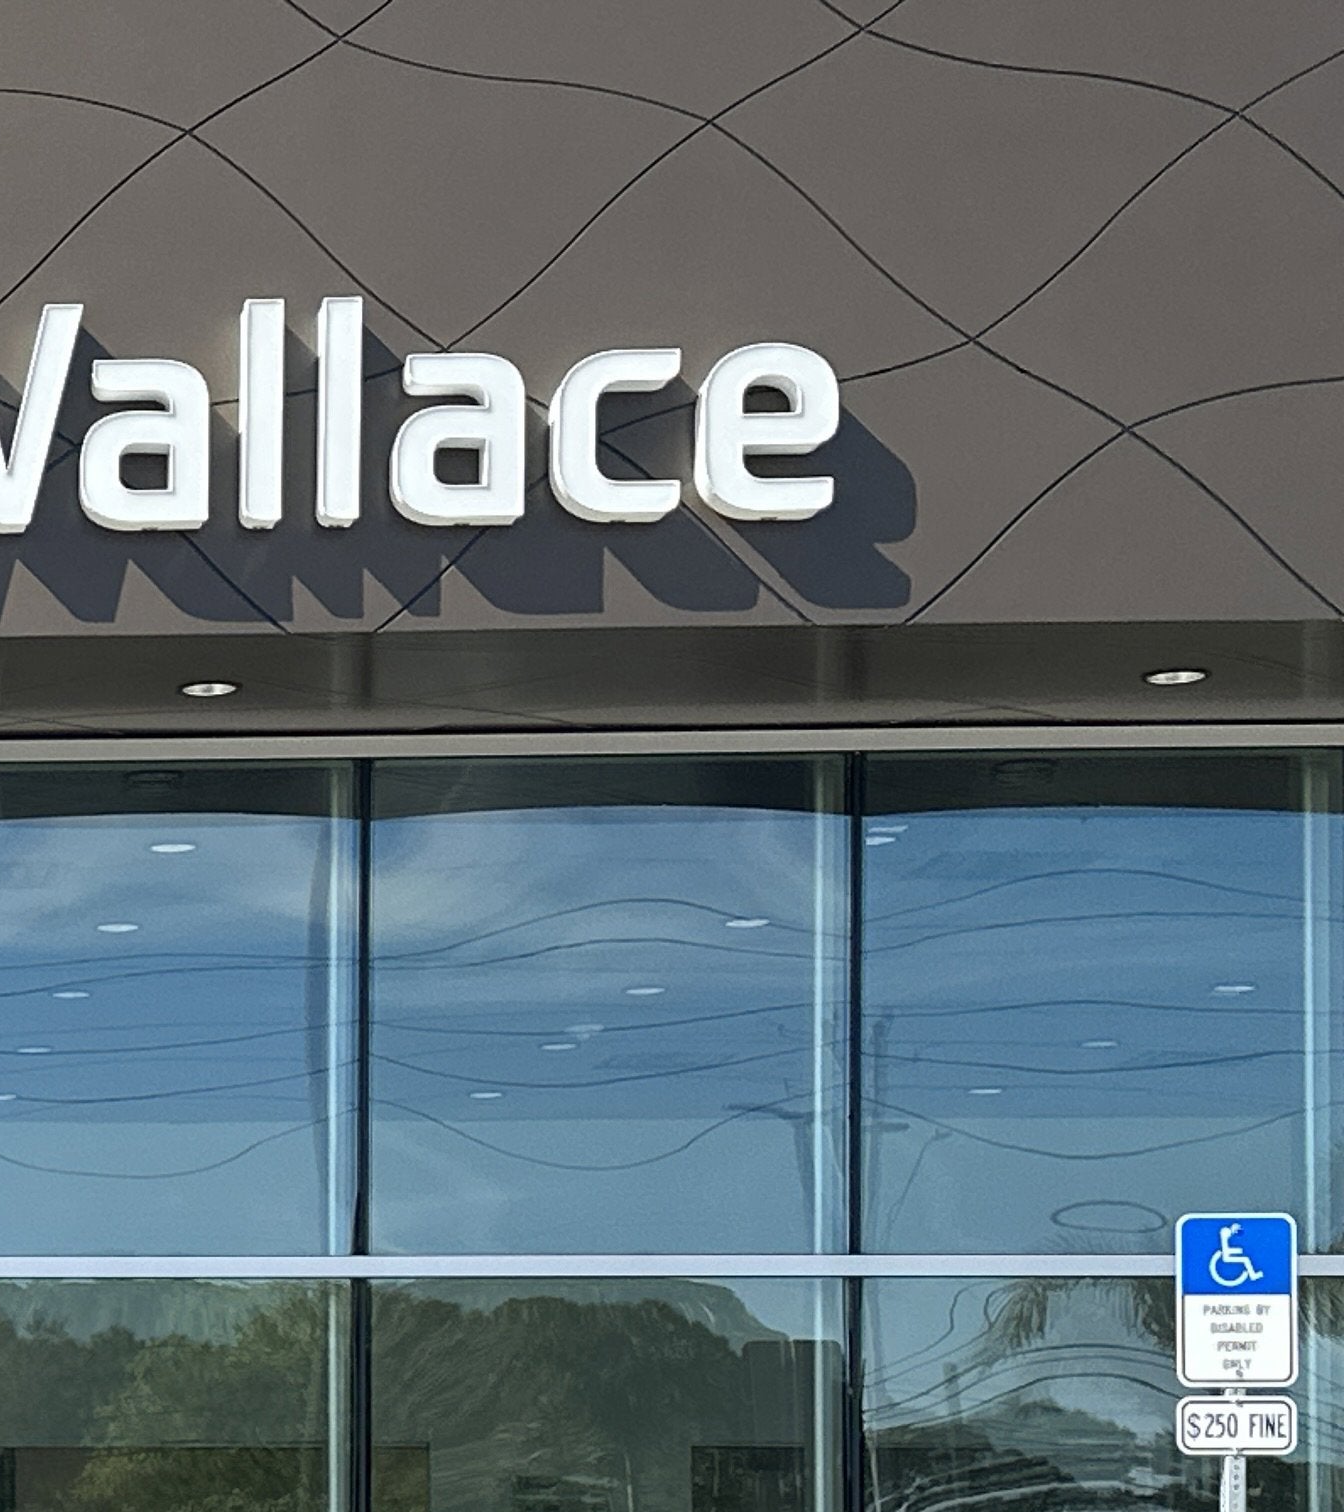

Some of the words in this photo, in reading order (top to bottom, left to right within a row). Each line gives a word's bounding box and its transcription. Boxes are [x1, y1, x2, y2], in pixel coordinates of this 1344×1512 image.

[1202, 1304, 1252, 1316] PARKING
[1210, 1322, 1264, 1334] DISABLED
[1216, 1340, 1258, 1352] PERMIT
[1186, 1412, 1239, 1440] $250
[1248, 1413, 1288, 1439] FINE
